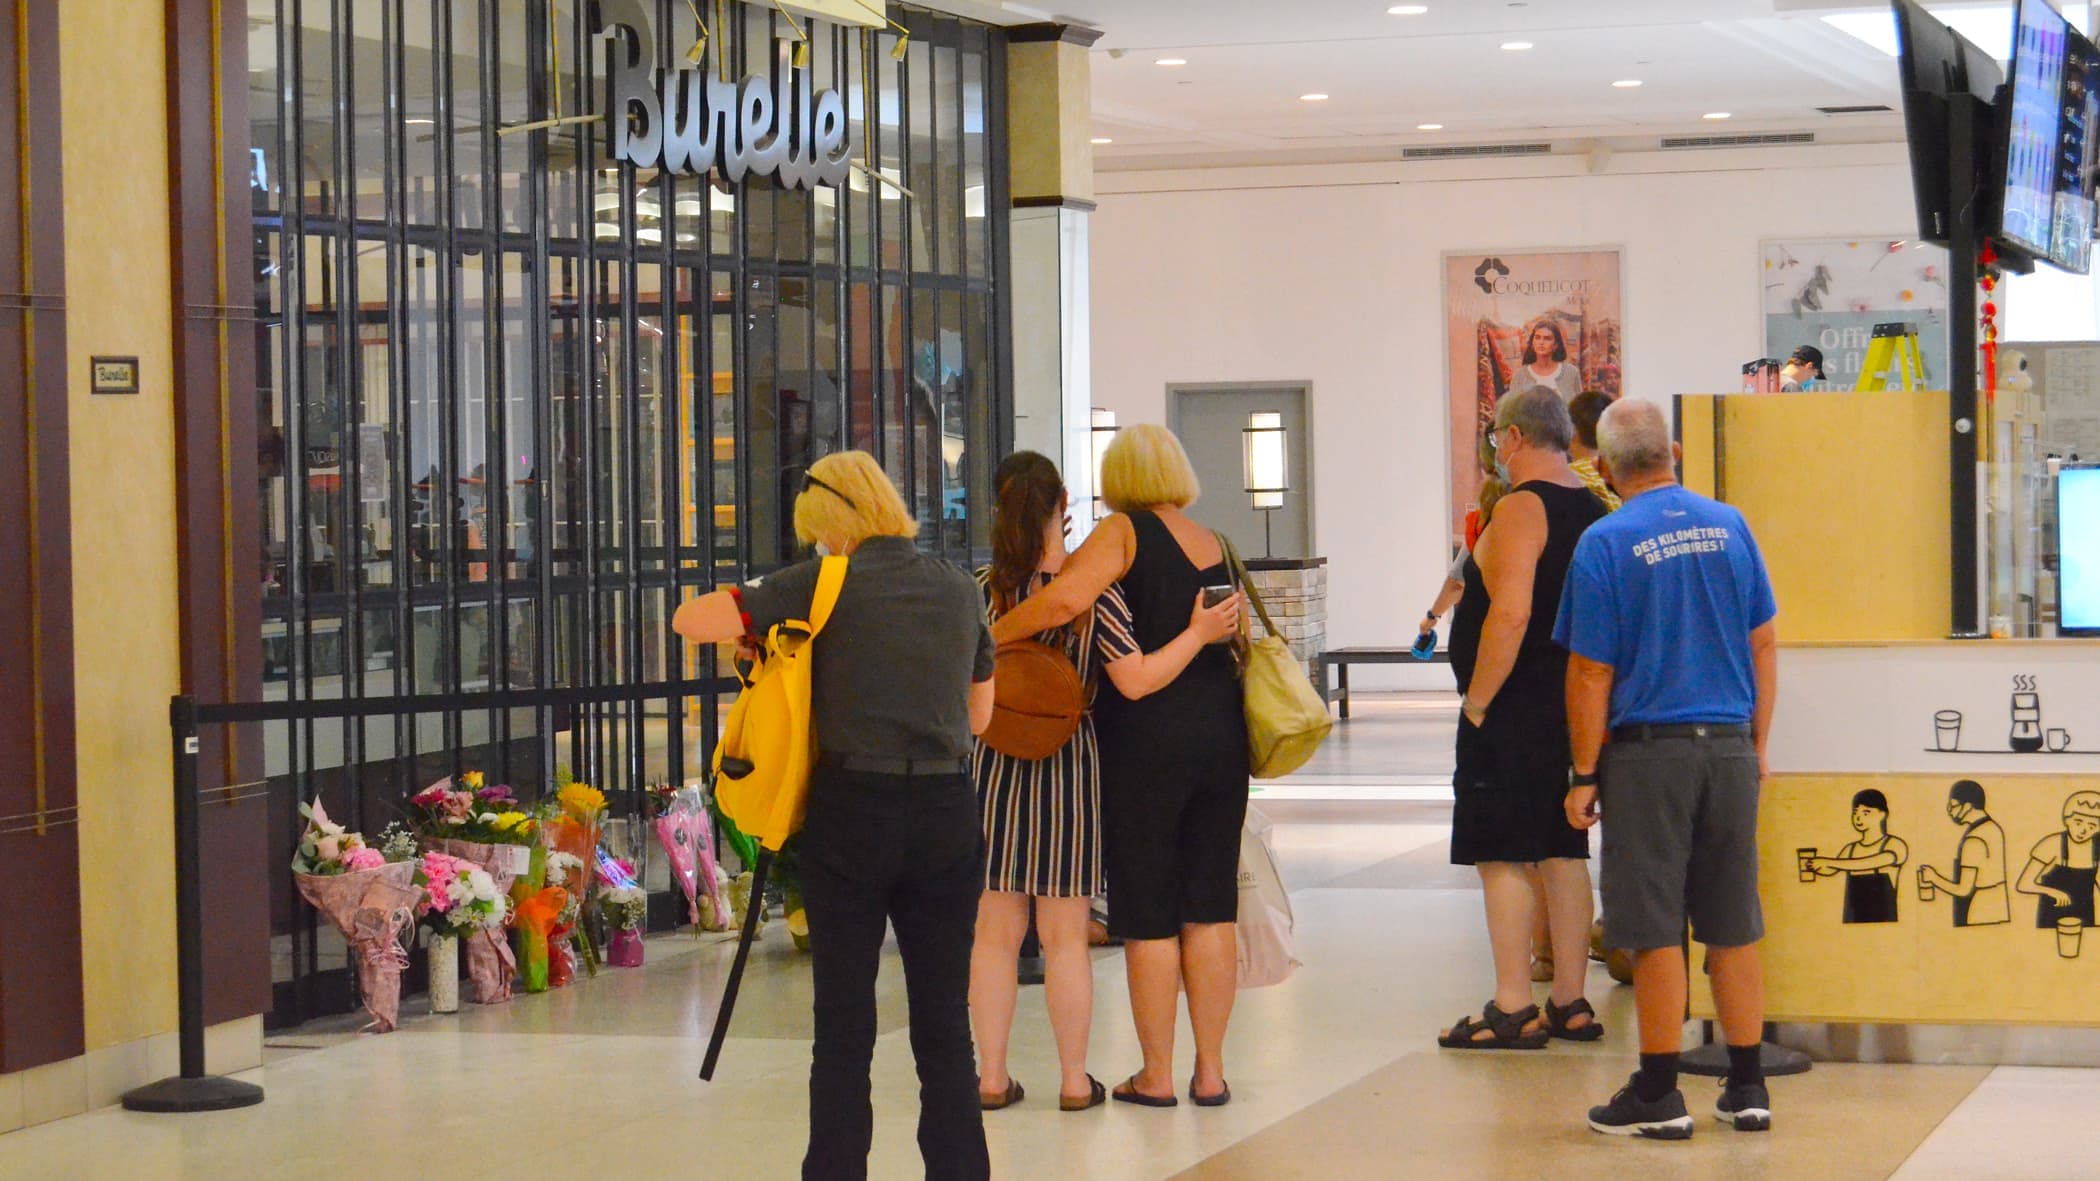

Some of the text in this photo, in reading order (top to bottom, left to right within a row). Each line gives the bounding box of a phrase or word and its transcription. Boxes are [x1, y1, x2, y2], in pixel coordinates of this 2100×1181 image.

[592, 0, 851, 190] Burelle
[1632, 525, 1729, 557] DES KILOMÈTRES
[1645, 550, 1663, 566] DE
[1663, 540, 1718, 559] SOURIRES
